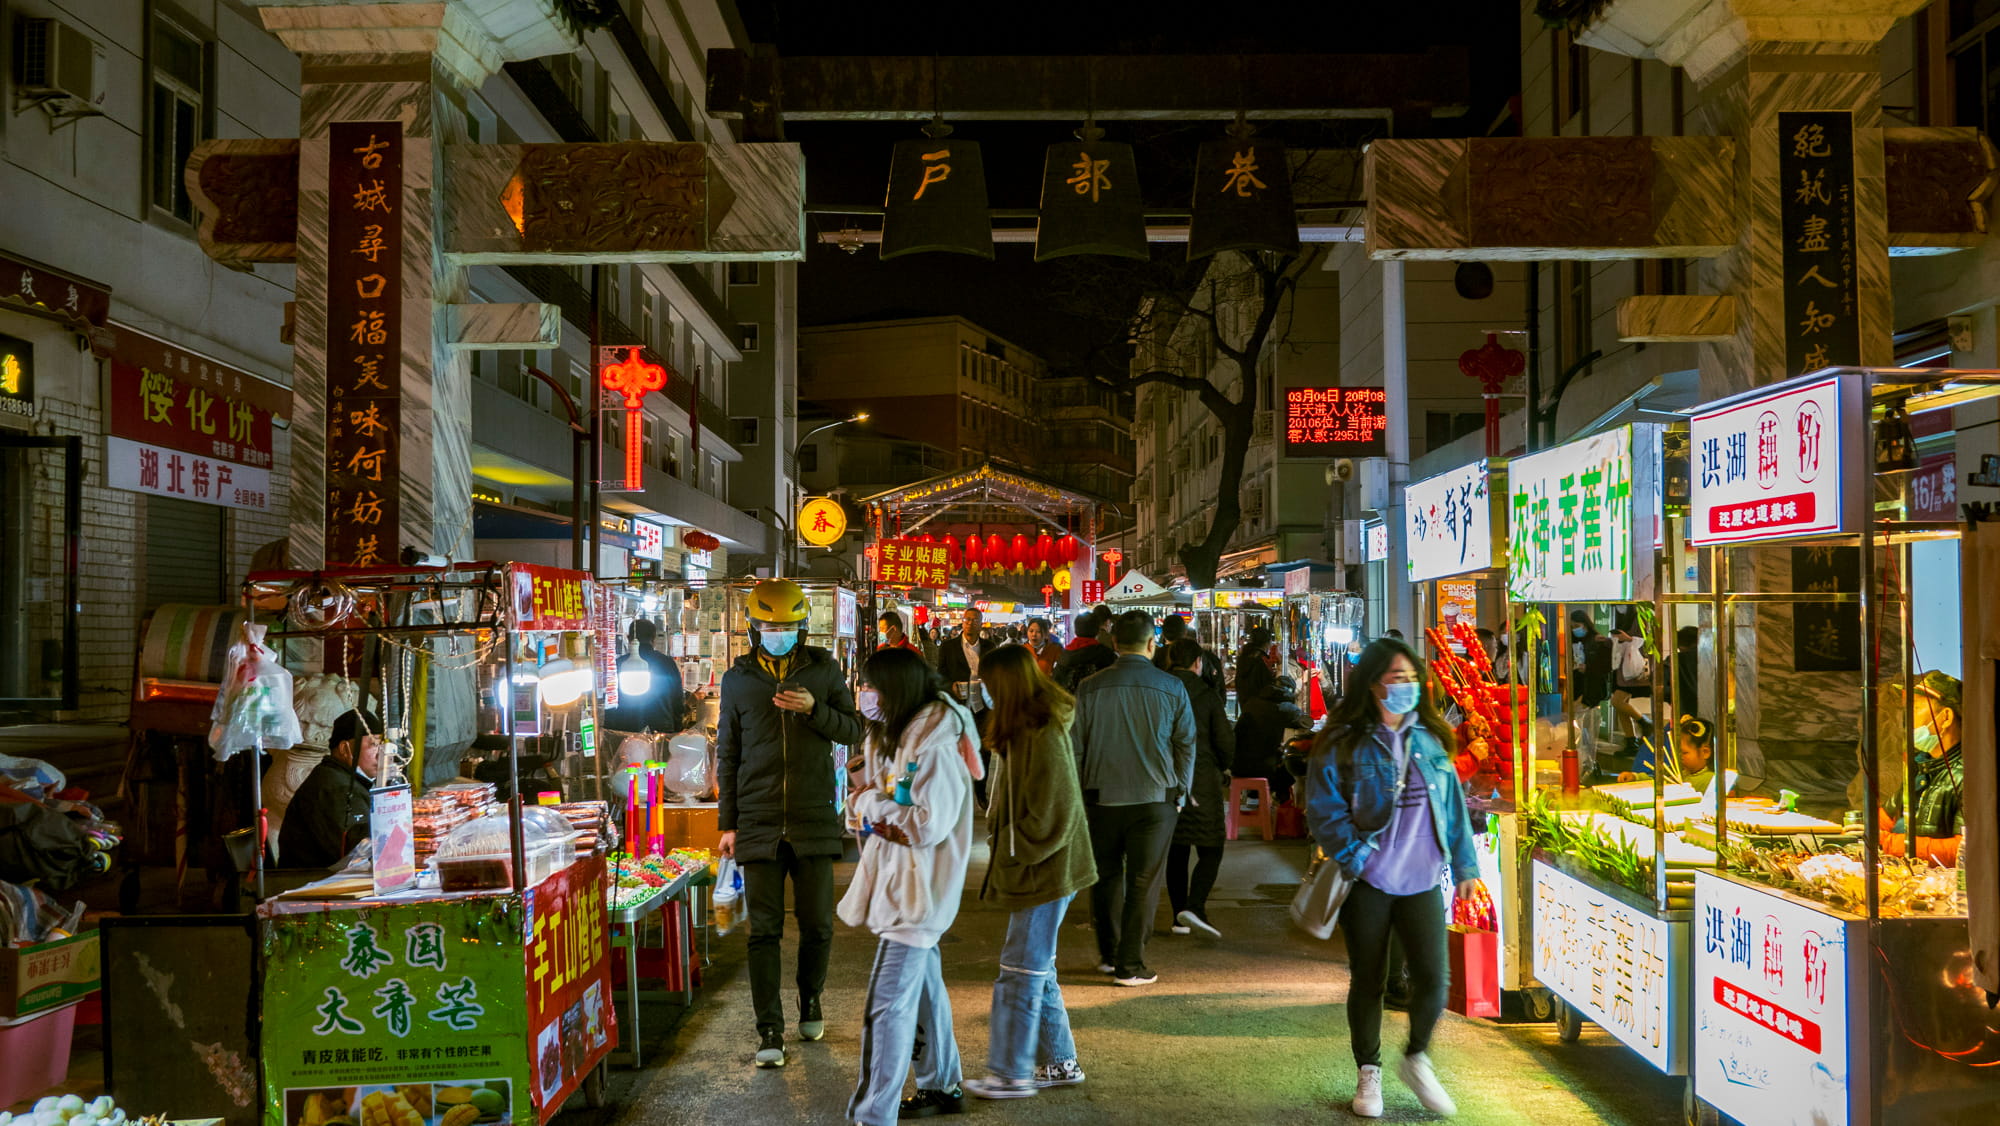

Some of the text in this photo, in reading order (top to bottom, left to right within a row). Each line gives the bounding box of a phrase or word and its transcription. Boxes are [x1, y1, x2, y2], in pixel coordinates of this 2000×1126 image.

[1288, 388, 1339, 403] 03月04日
[138, 448, 233, 500] 湖北特产
[812, 509, 835, 532] 春
[882, 544, 948, 565] 专业贴膜
[881, 564, 946, 585] 手机外壳
[341, 922, 447, 979] 泰国
[312, 976, 485, 1037] 大青芒
